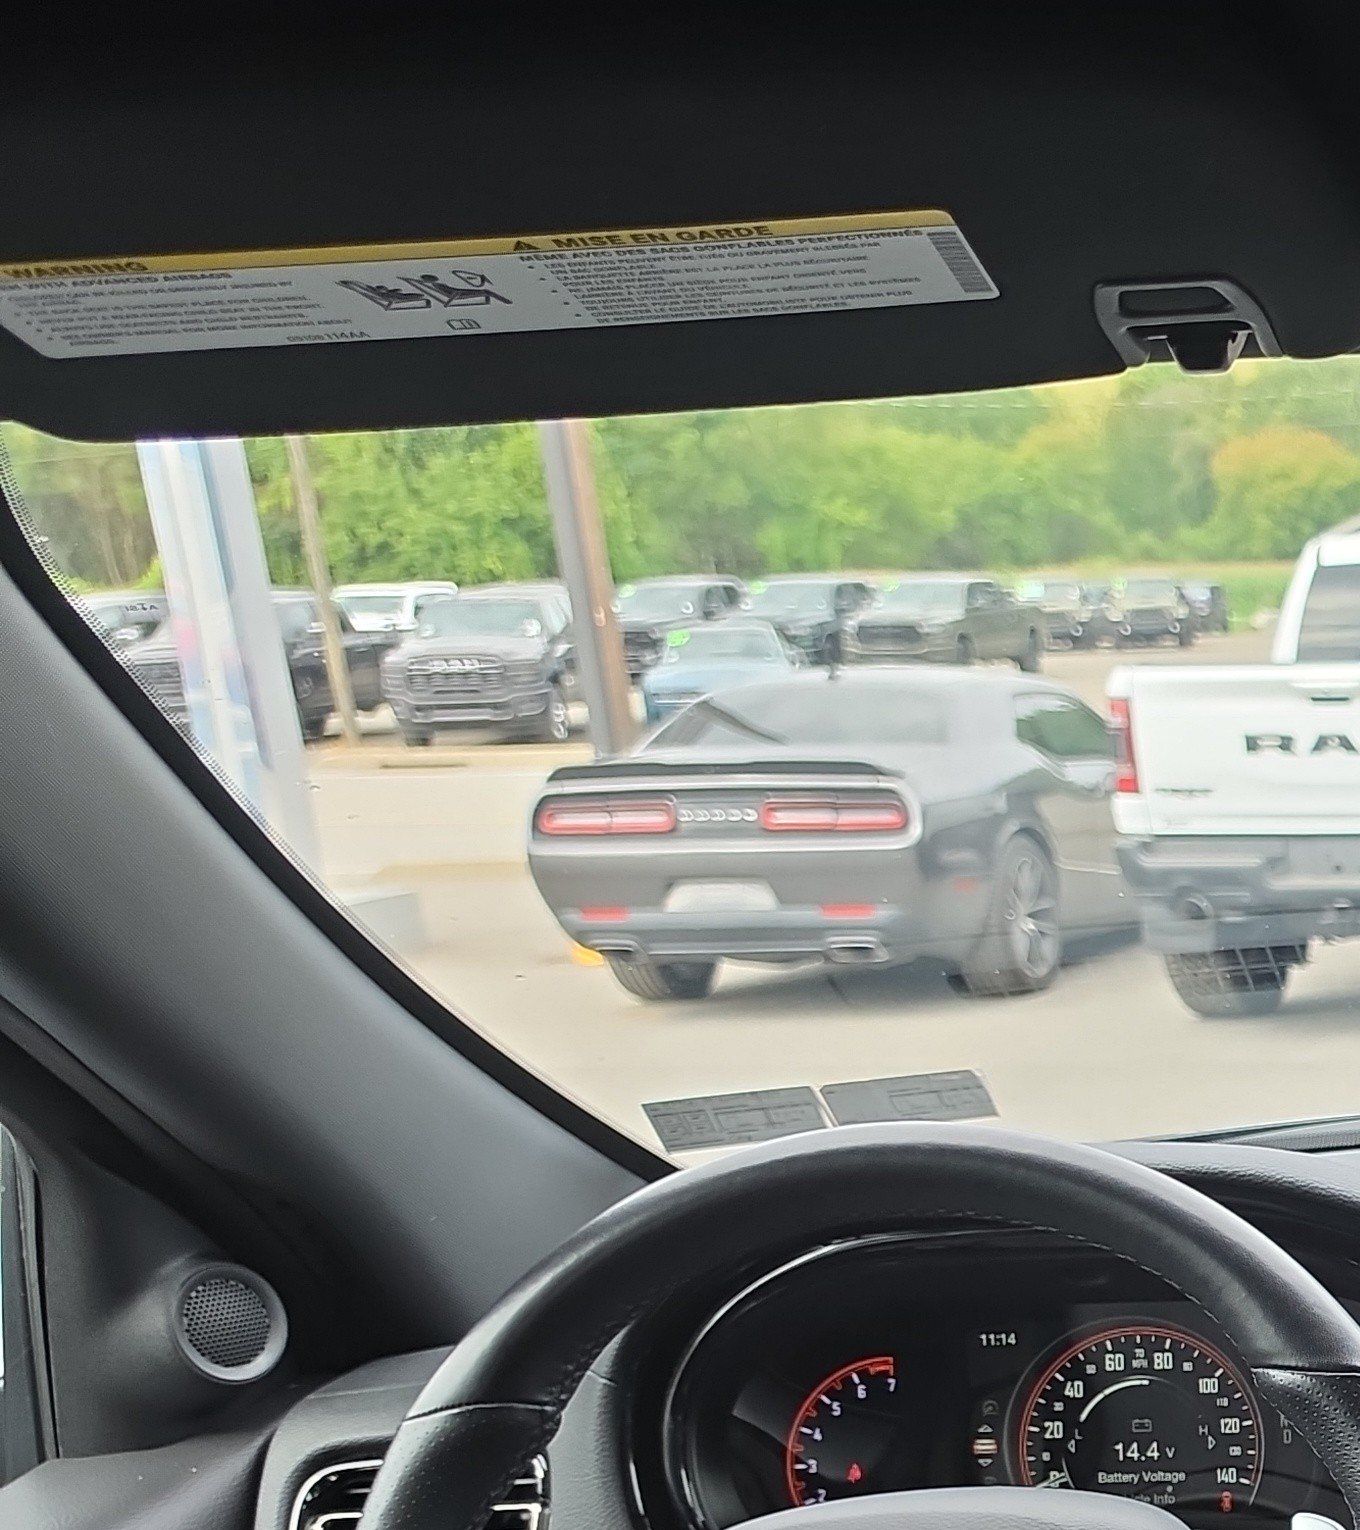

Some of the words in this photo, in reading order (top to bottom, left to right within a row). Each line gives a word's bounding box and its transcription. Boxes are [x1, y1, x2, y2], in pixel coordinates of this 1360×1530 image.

[552, 235, 627, 249] MISE
[629, 232, 671, 245] EN
[675, 225, 774, 242] GARDE
[572, 250, 610, 260] AVEC
[615, 248, 647, 258] DES
[11, 262, 148, 278] WARNING
[979, 1333, 1017, 1347] 11:14
[1104, 1353, 1125, 1371] 60
[1131, 1358, 1149, 1369] MPH
[1152, 1352, 1173, 1370] 80
[856, 1384, 868, 1399] 6
[887, 1378, 897, 1393] 7
[1064, 1381, 1085, 1399] 40
[1198, 1378, 1219, 1394] 100
[831, 1401, 842, 1417] 5
[1043, 1421, 1064, 1439] 20
[1219, 1418, 1240, 1434] 120
[812, 1427, 824, 1442] 4
[1113, 1440, 1160, 1462] 14.4
[807, 1458, 819, 1474] 3
[1098, 1470, 1140, 1485] Battery
[1142, 1470, 1186, 1485] Voltage
[1216, 1467, 1238, 1483] 140
